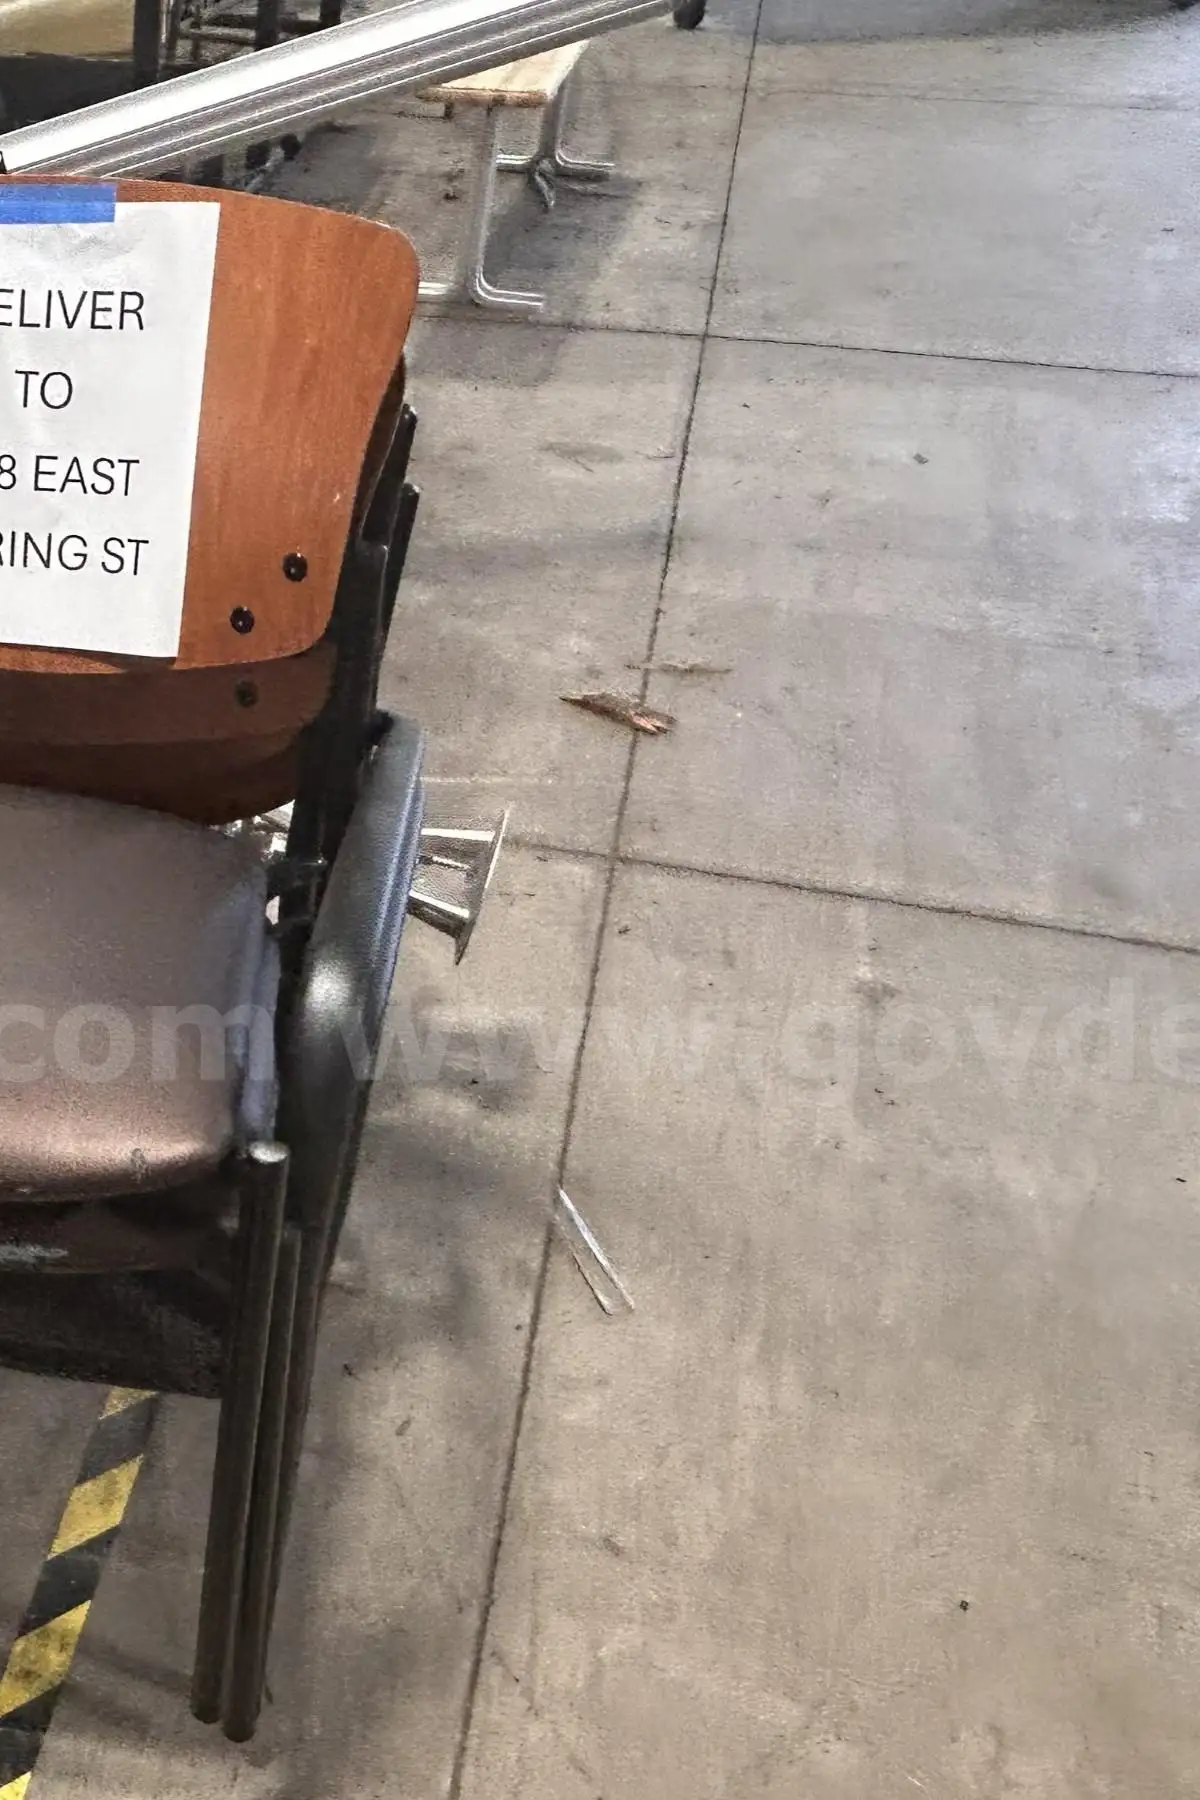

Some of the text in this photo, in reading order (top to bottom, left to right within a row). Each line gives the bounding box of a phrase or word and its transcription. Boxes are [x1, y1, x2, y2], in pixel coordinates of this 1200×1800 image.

[14, 369, 74, 410] TO
[33, 455, 140, 497] EAST
[100, 536, 150, 576] ST
